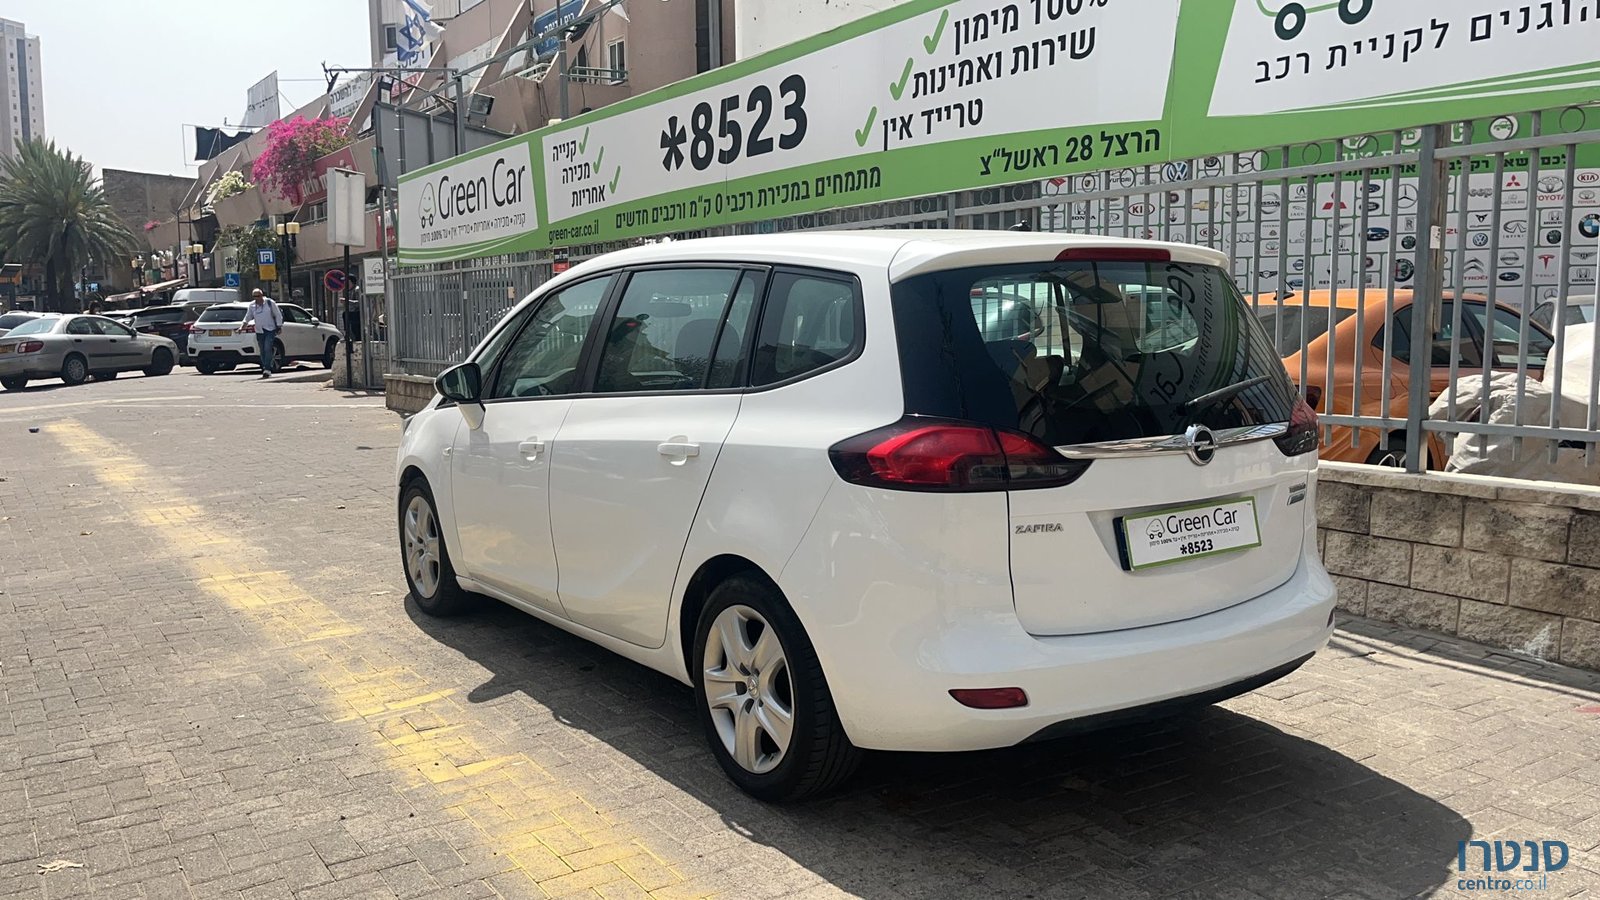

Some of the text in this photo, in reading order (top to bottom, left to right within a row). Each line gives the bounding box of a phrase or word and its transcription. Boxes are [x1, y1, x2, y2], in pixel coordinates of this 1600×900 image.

[954, 4, 1019, 55] מימון
[912, 26, 1097, 99] שירות ואמינות
[1255, 18, 1450, 84] לקניית רכב
[882, 98, 984, 151] טרייד אין
[552, 140, 577, 162] קנייה
[1066, 135, 1093, 163] 28
[1100, 128, 1160, 159] הרצל
[562, 162, 590, 184] מכירה
[815, 166, 881, 198] מתמחים
[438, 158, 526, 219] Green Car
[572, 185, 606, 208] אחריות
[757, 180, 810, 208] במכירת
[652, 201, 686, 224] ורכבים
[715, 193, 723, 214] 0
[726, 191, 754, 213] רכבי
[616, 209, 649, 229] חדשים
[548, 220, 599, 245] green-car.co.il
[1015, 522, 1064, 534] ZAFIRA
[1166, 508, 1238, 534] Green Car
